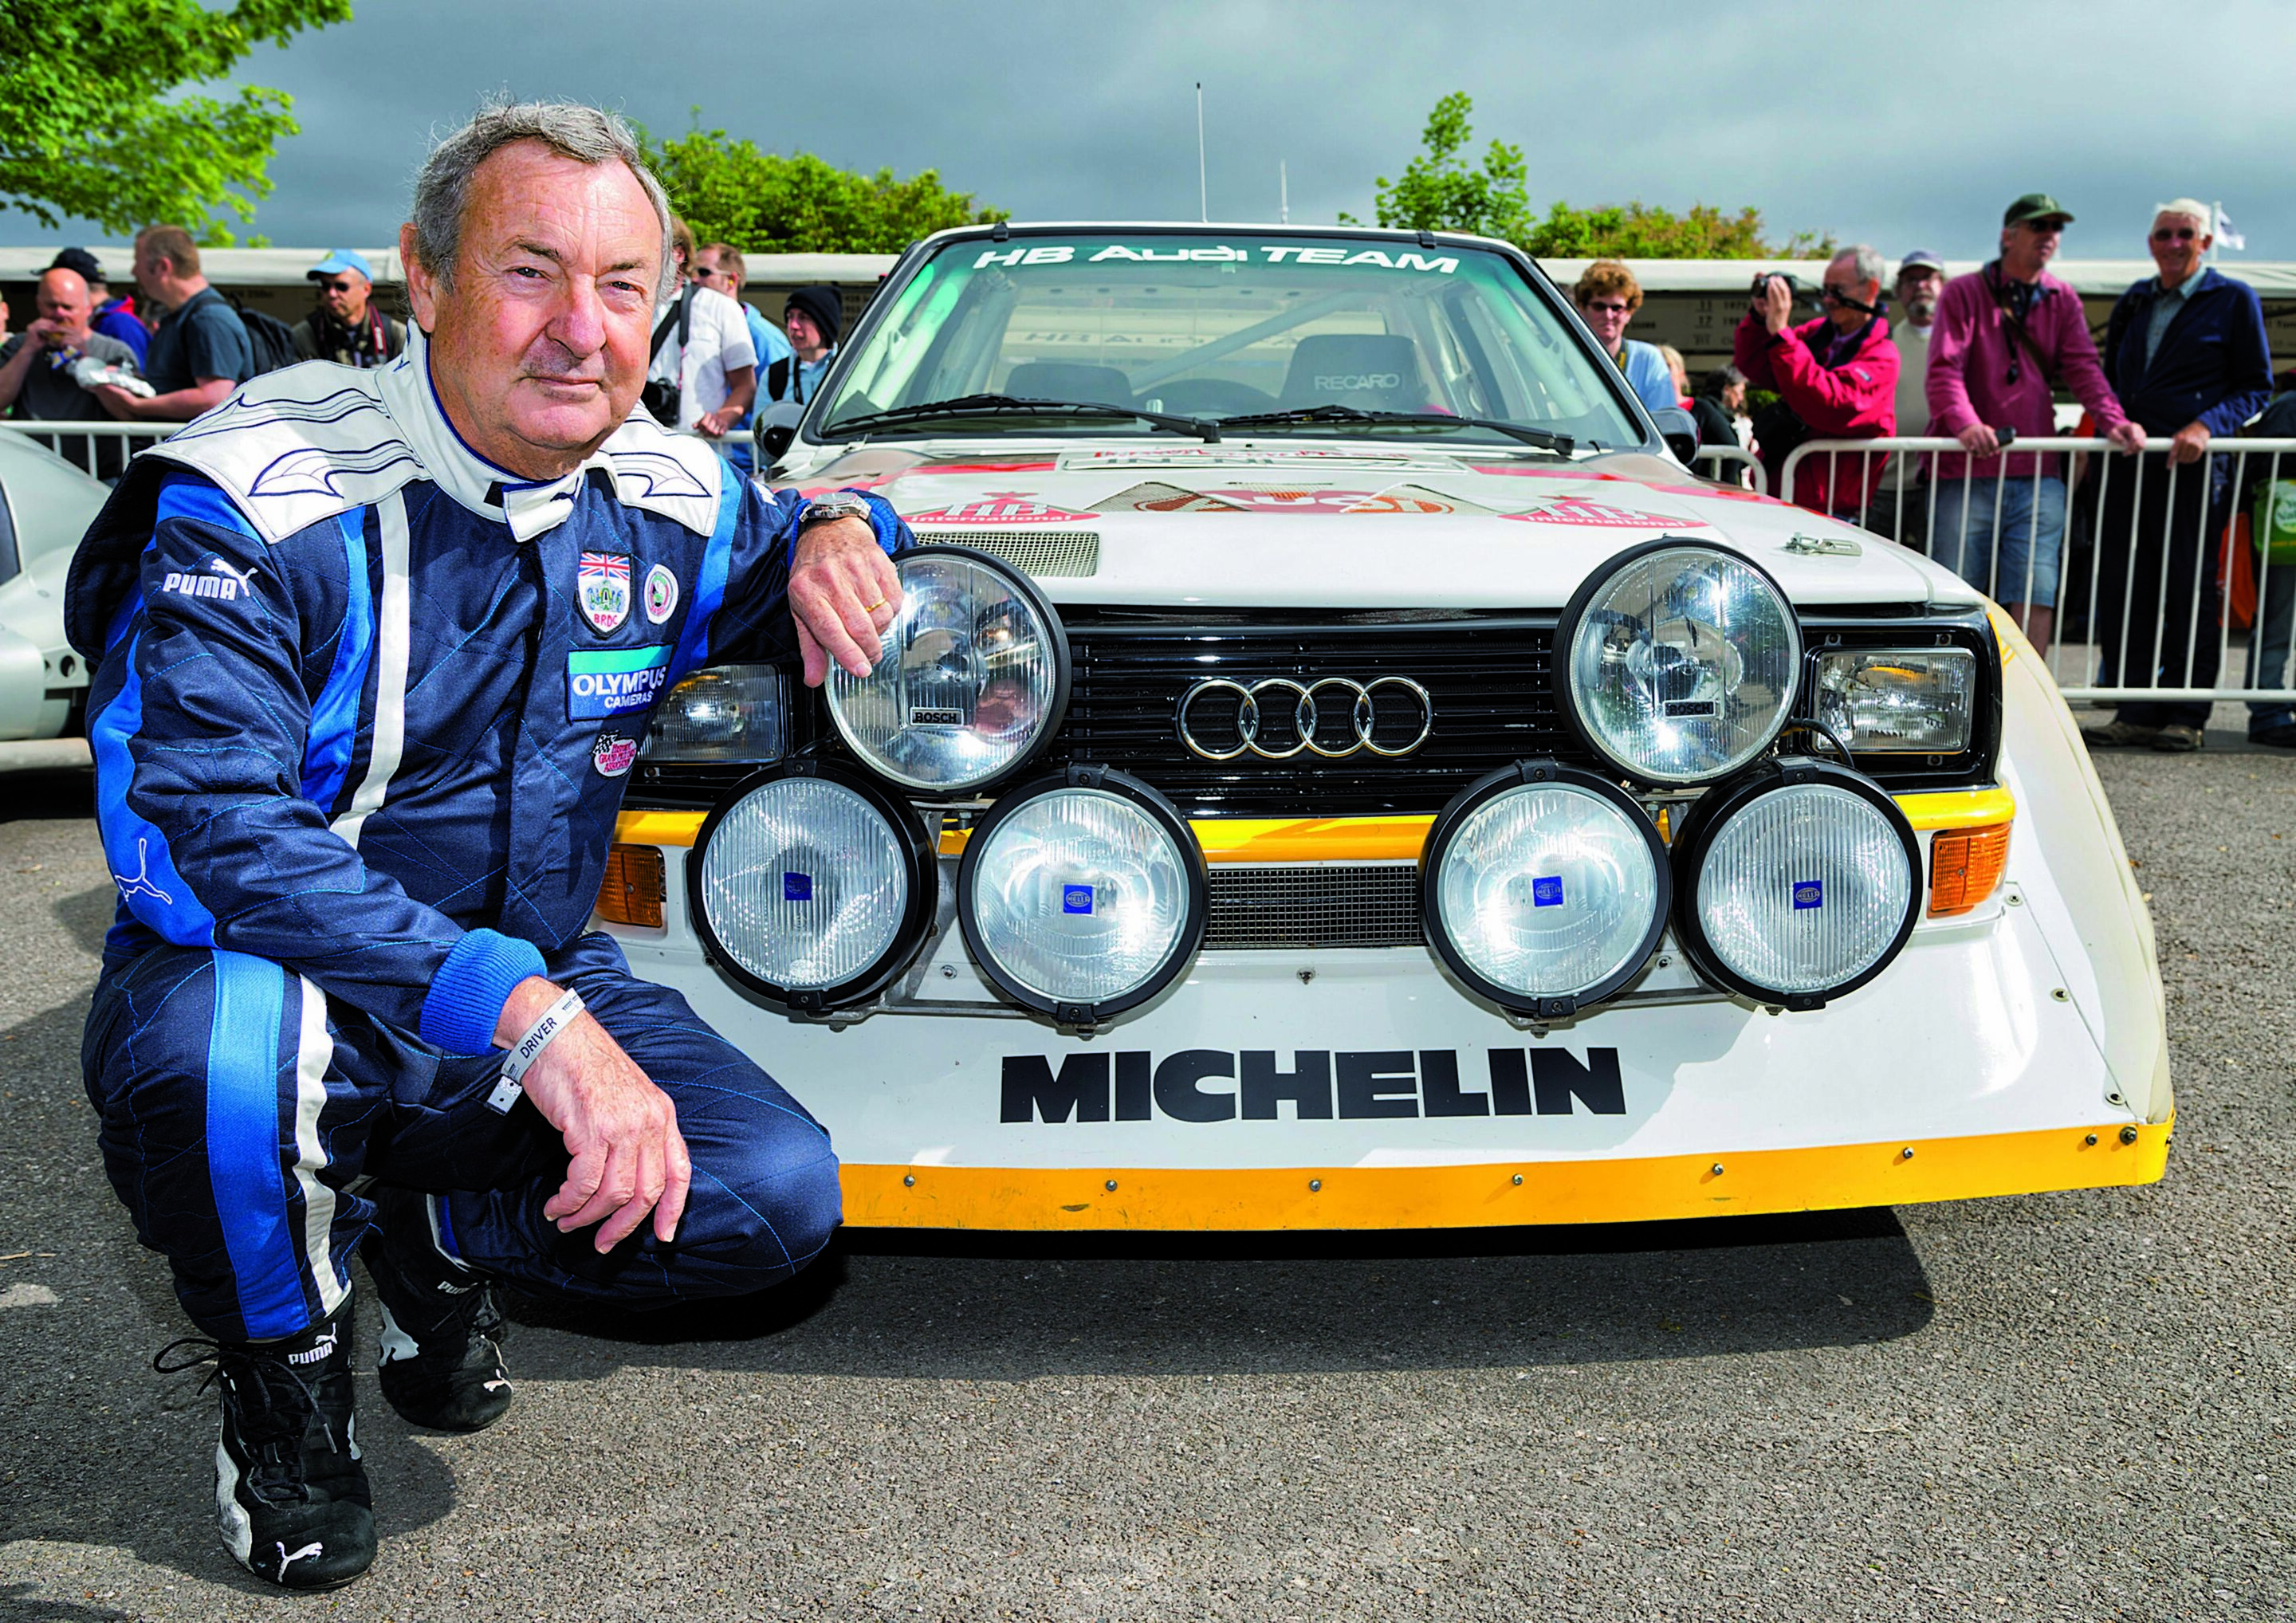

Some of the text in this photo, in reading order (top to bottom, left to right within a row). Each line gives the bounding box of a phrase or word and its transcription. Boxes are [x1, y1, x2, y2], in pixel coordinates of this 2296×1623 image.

[973, 245, 1460, 274] HB Audi TEAM
[1315, 373, 1401, 391] RECARO
[944, 504, 1049, 517] HB
[1535, 505, 1649, 521] HB
[162, 572, 238, 601] PUMA
[593, 613, 618, 627] BRDC
[572, 666, 666, 696] OLYMPUS
[603, 690, 654, 709] CAMERAS
[914, 712, 957, 723] BOSCH
[1669, 703, 1711, 716] BOSCH
[520, 1016, 558, 1059] DRIVER
[1000, 1047, 1627, 1124] MICHELIN
[288, 1342, 333, 1366] PUMA
